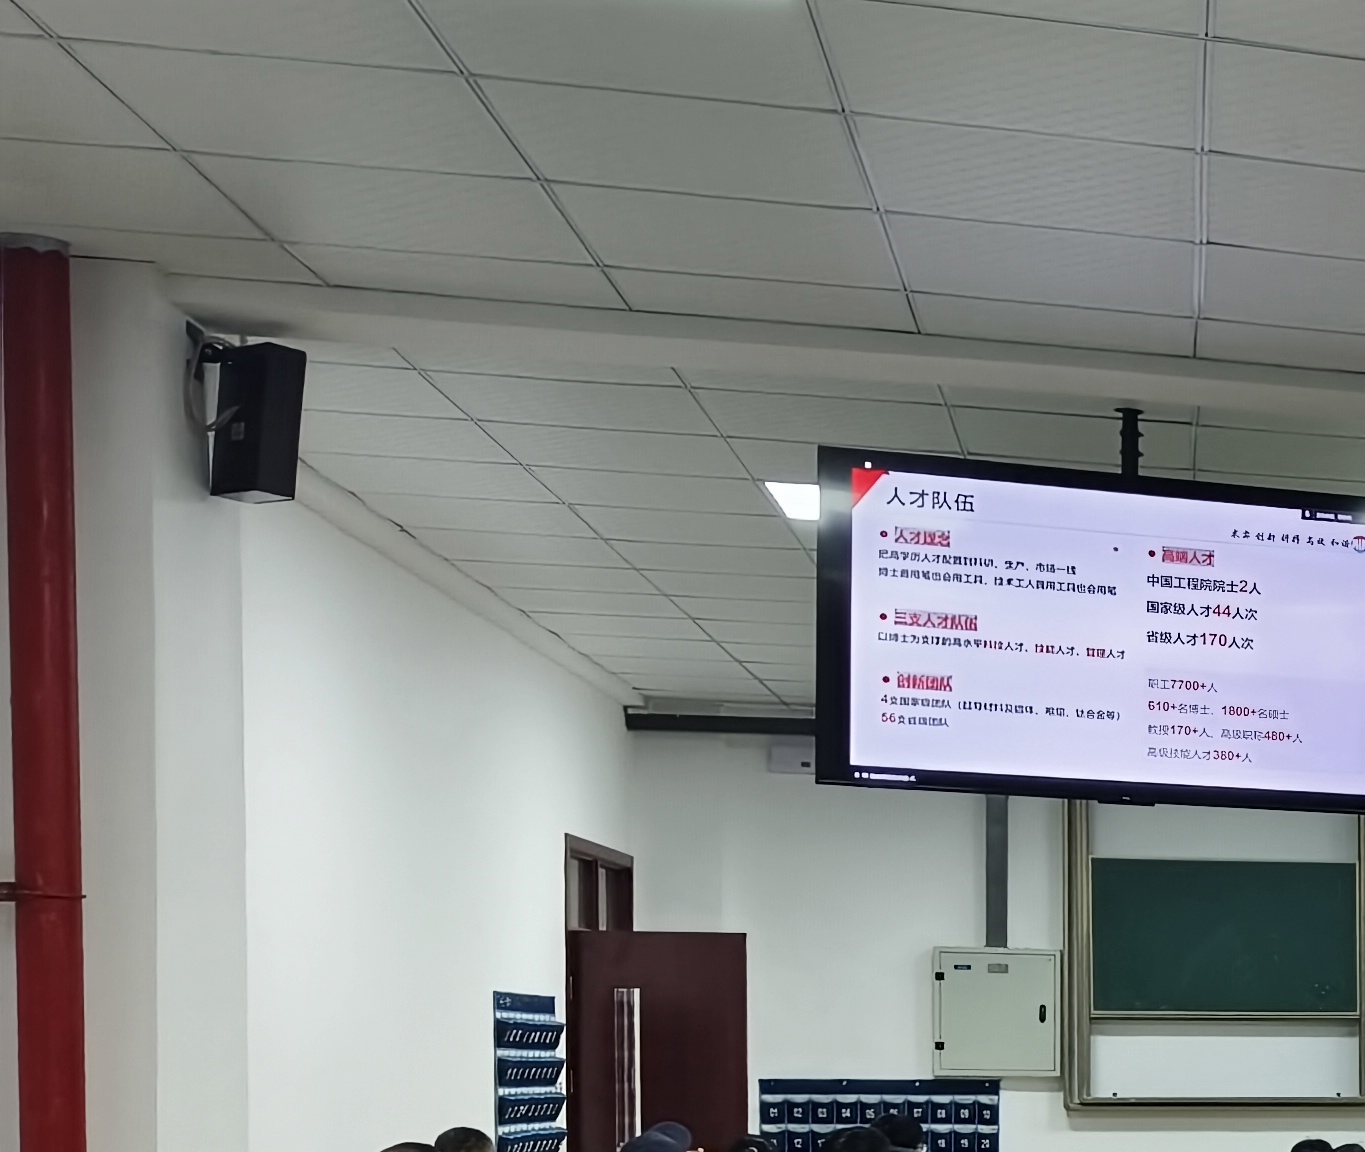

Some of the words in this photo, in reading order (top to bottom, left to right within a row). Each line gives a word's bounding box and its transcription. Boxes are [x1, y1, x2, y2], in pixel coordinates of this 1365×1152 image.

[886, 486, 975, 512] 人才队伍
[1162, 547, 1214, 567] 高端人才
[1147, 575, 1261, 595] 中国工程院院士2人
[894, 609, 978, 631] 三支人才队伍
[1147, 601, 1257, 620] 国家级人才44人次
[1147, 630, 1254, 650] 省级人才170人次
[1148, 678, 1217, 693] 职工7700+人
